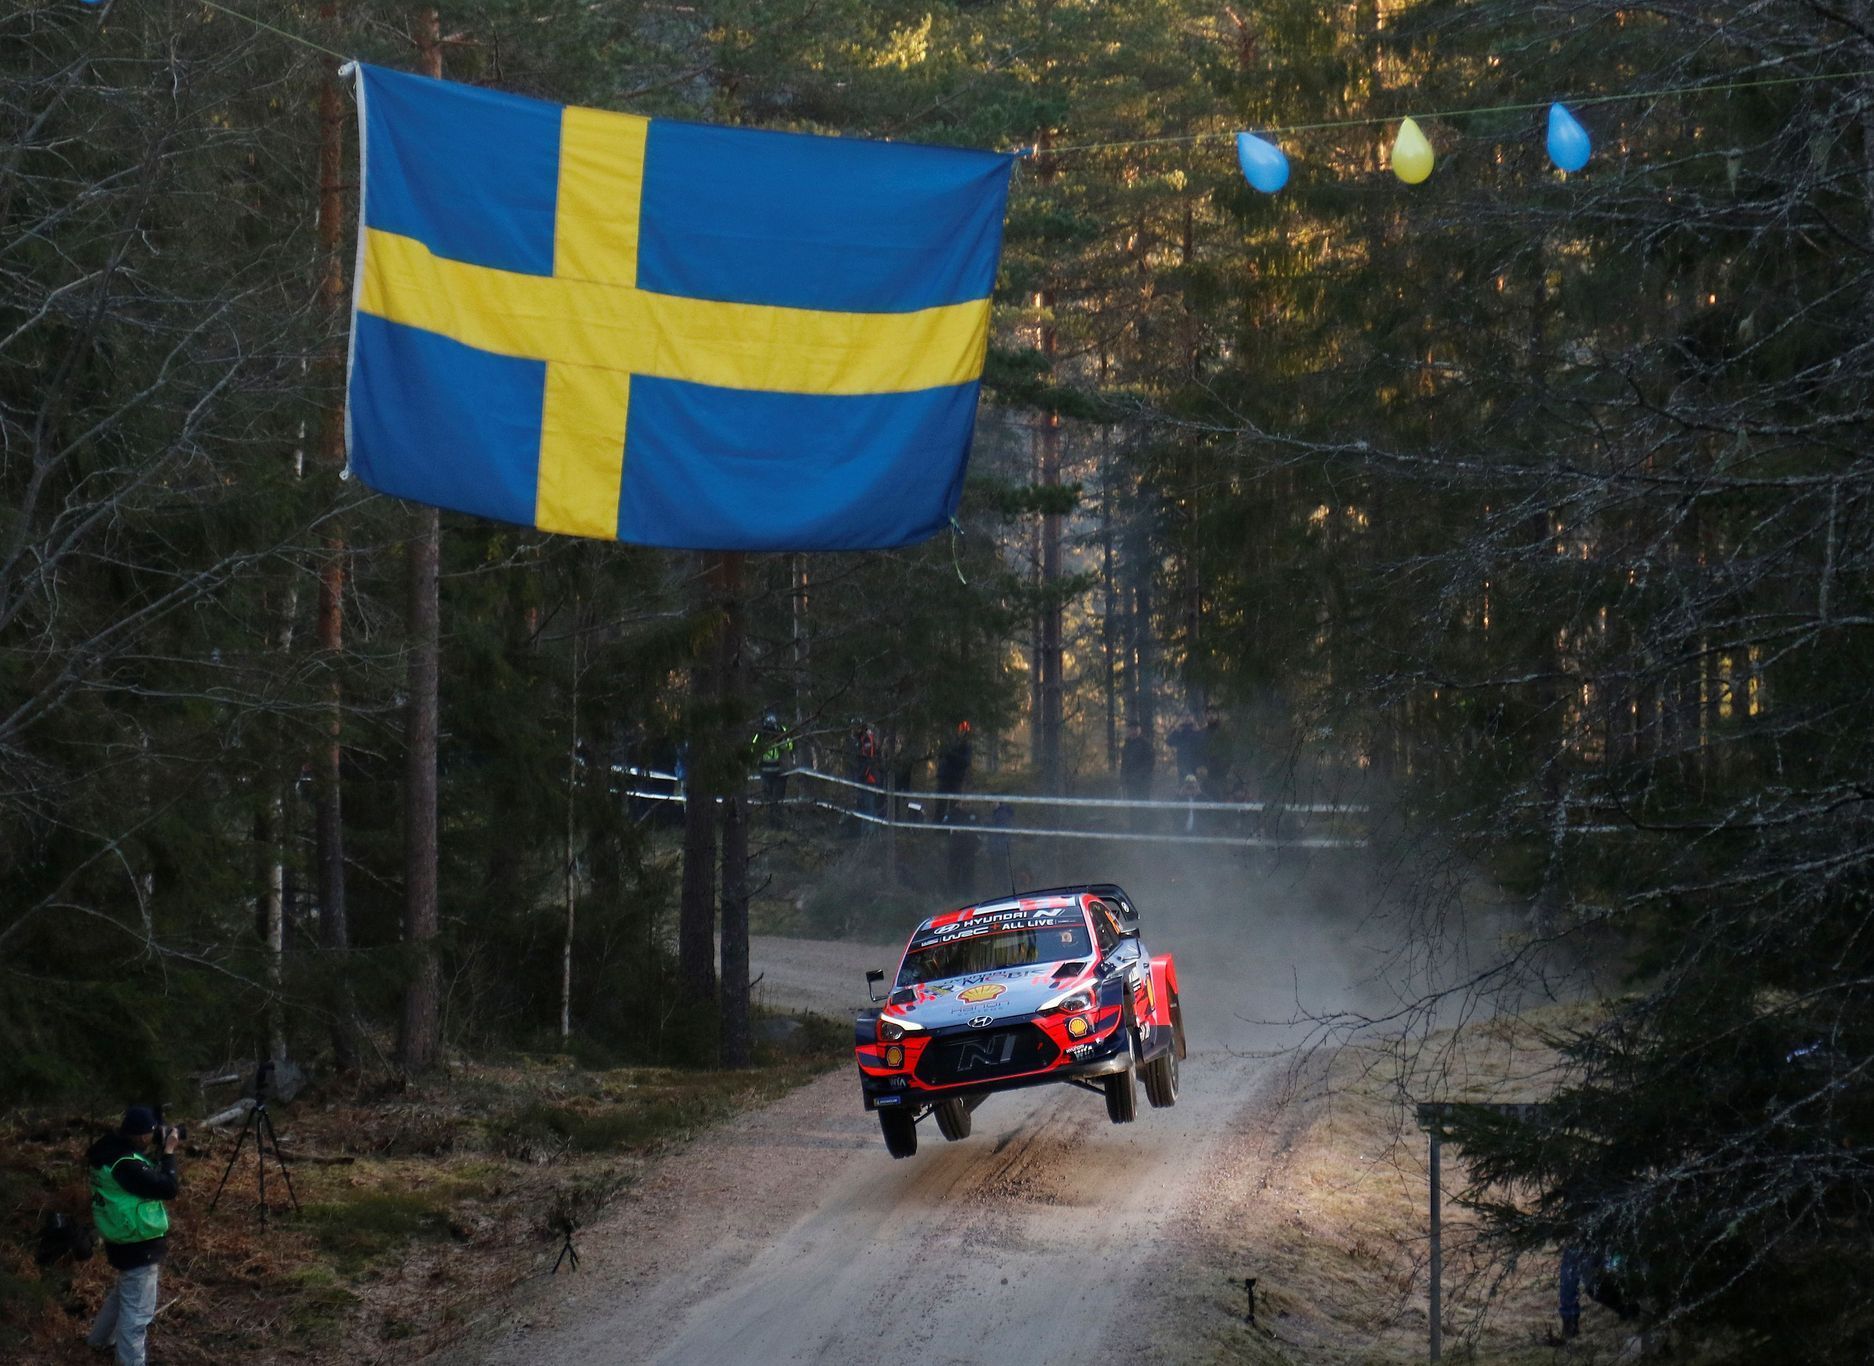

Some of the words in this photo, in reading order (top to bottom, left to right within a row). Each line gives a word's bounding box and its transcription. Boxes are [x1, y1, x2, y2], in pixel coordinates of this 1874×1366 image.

[942, 926, 989, 942] WRC
[1002, 922, 1025, 931] ALL
[1028, 914, 1054, 926] LIVE
[964, 911, 1027, 928] HYUNDAI
